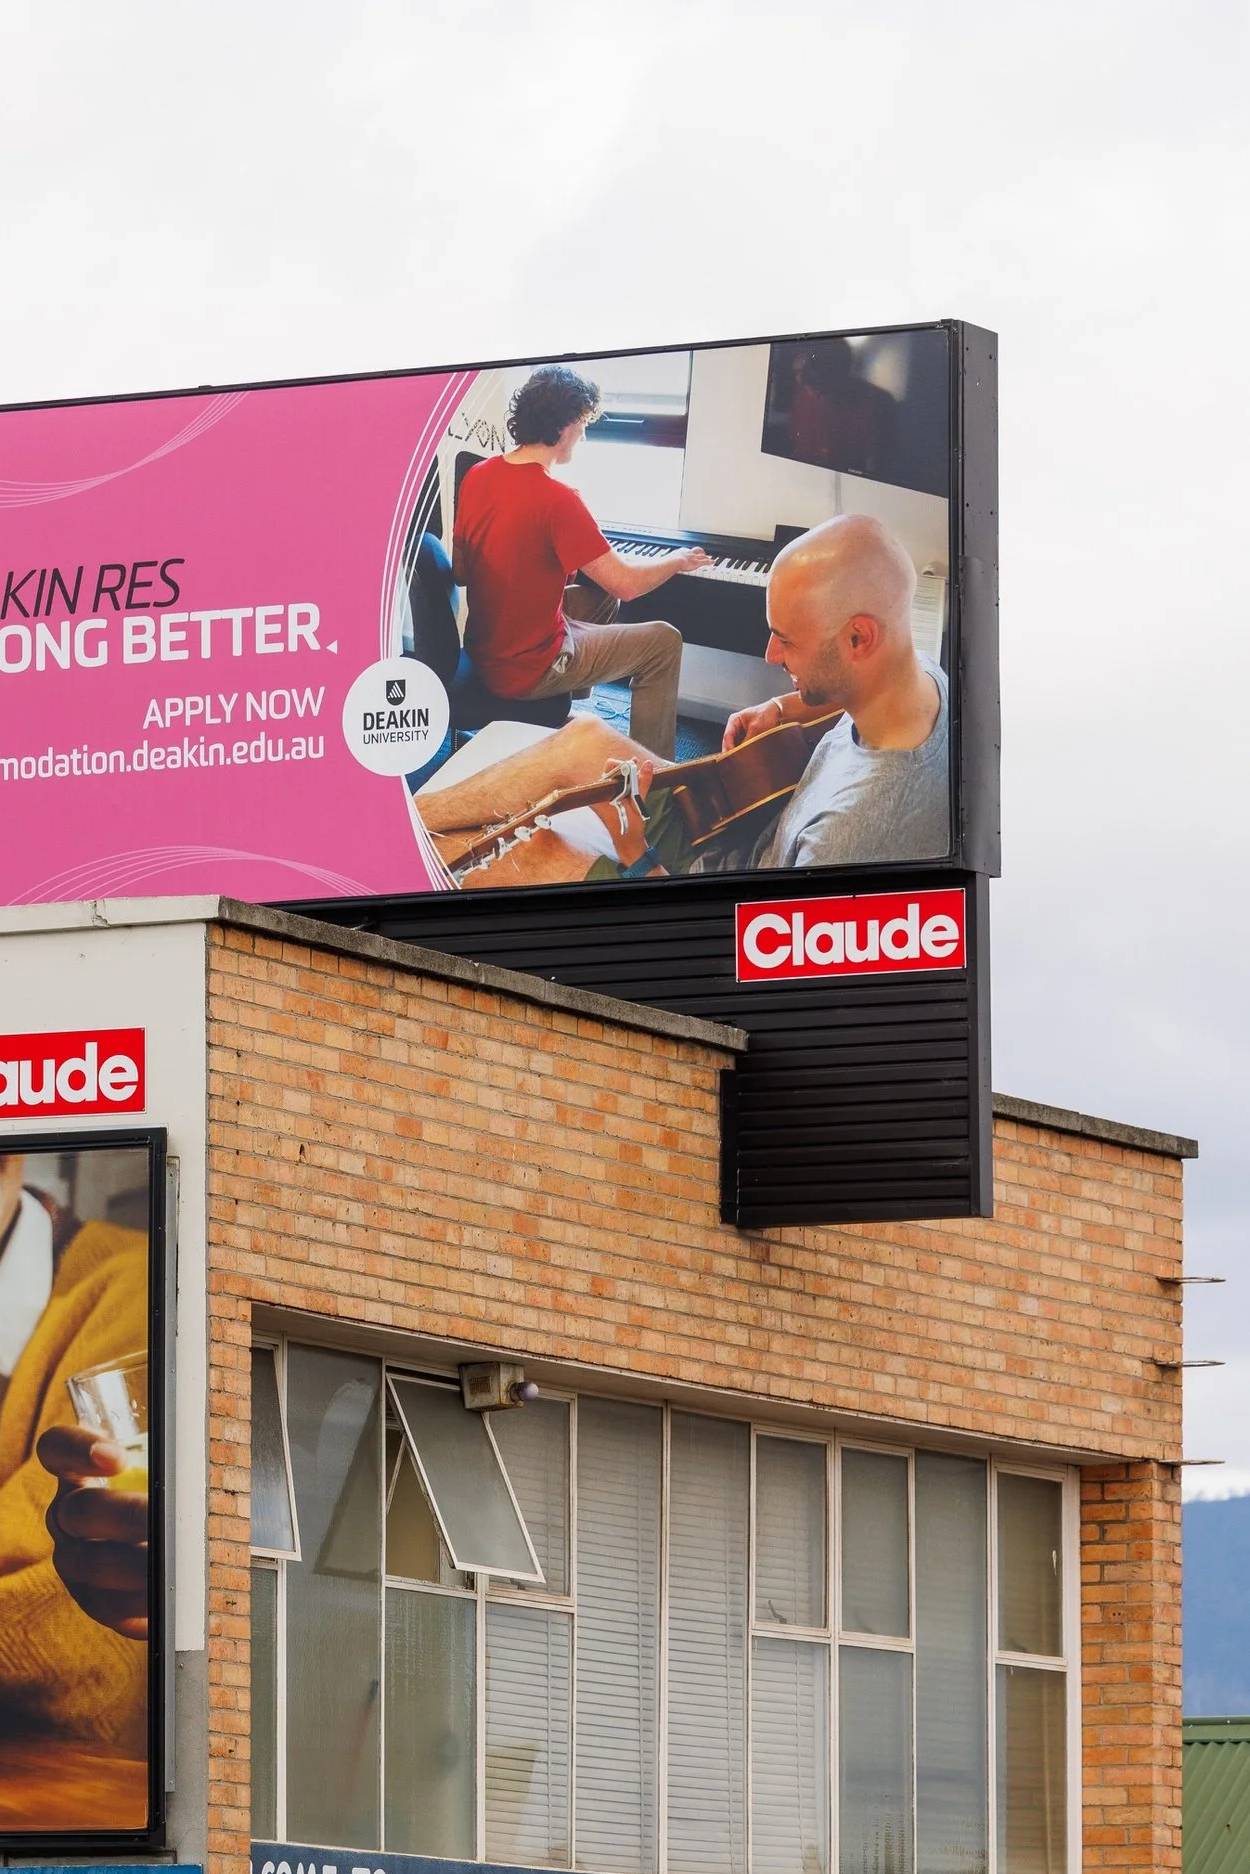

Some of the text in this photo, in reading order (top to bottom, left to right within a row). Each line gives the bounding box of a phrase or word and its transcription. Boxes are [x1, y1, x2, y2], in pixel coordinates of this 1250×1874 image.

[92, 557, 186, 612] RES
[123, 602, 321, 664] BETTER
[142, 686, 326, 729] APPLY NOW
[362, 708, 430, 731] DEAKIN
[362, 729, 430, 745] UNIVERSITY
[743, 903, 959, 967] Claude
